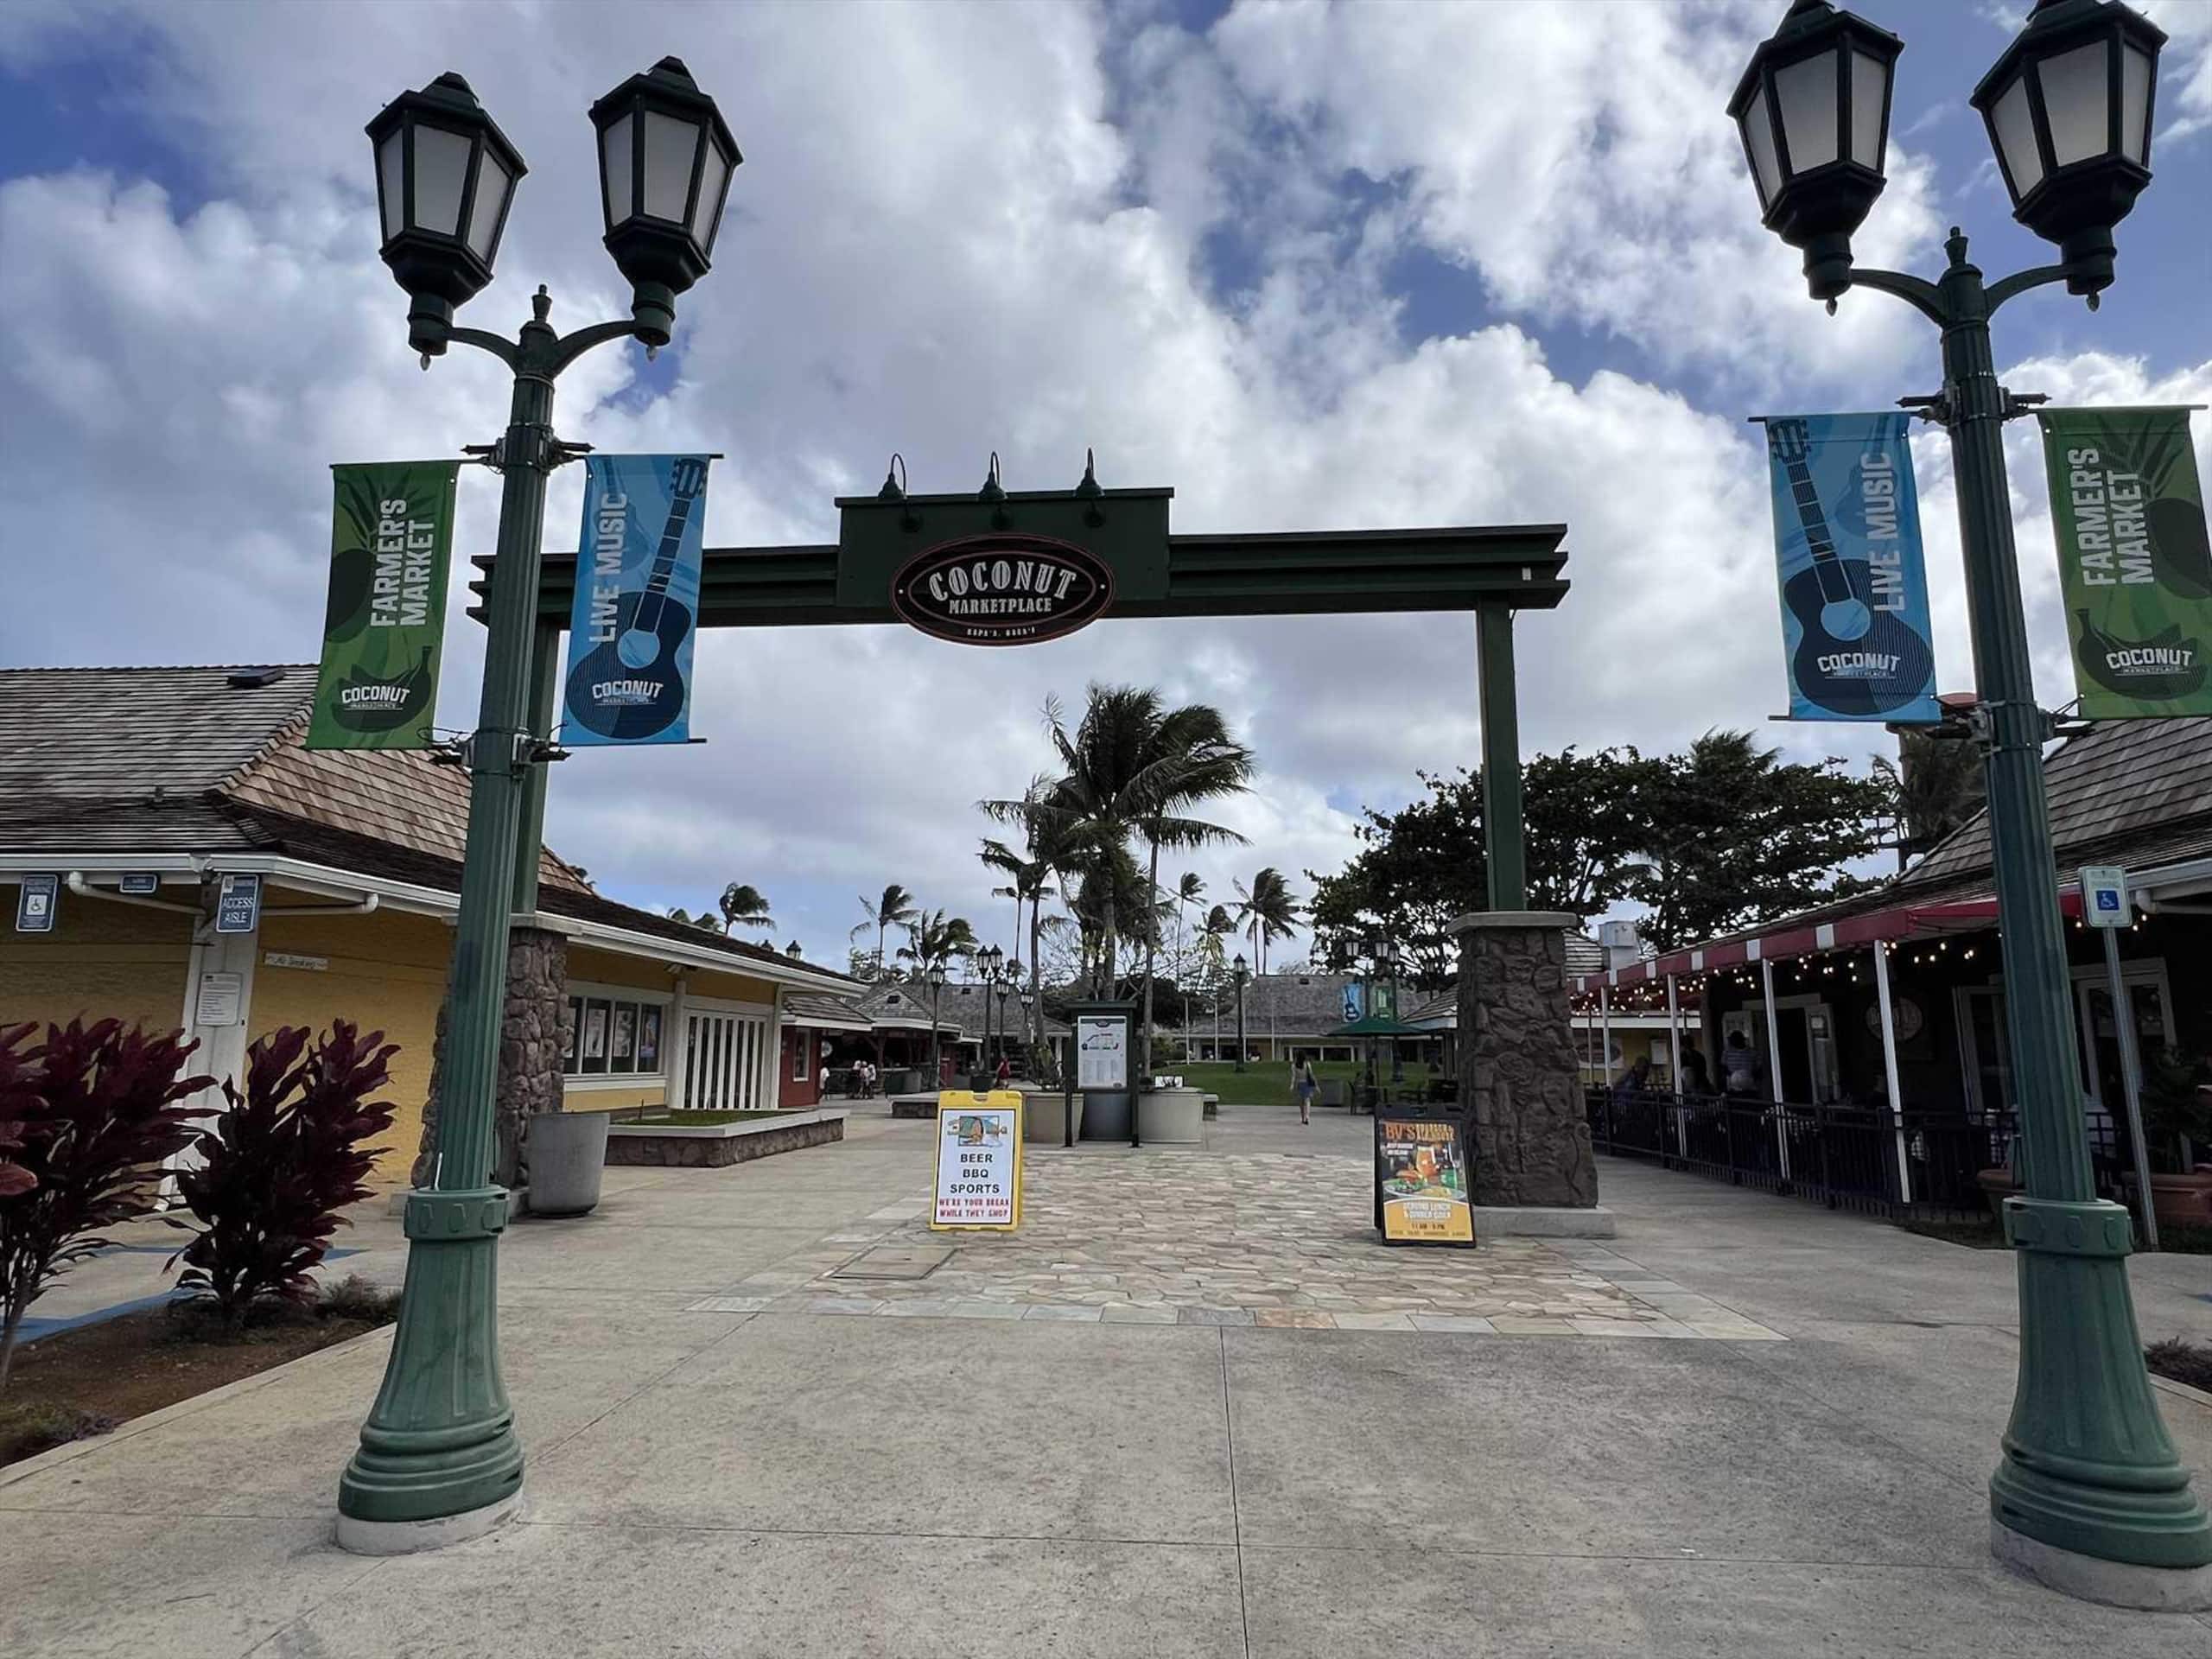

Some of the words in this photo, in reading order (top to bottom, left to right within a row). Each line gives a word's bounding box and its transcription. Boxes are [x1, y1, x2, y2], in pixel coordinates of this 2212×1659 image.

[1861, 452, 1897, 540] MUSIC
[596, 493, 627, 575] MUSIC
[2068, 448, 2116, 587] FARMER'S
[2107, 470, 2154, 584] MARKET
[370, 499, 408, 627] FARMER'S
[400, 521, 435, 626] MARKET
[929, 560, 1077, 601] COCONUT
[1869, 551, 1905, 612] LIVE
[588, 585, 620, 644] LIVE
[949, 597, 1052, 614] MARKETPLACE
[1817, 652, 1901, 672] COCONUT
[2106, 648, 2192, 669] COCONUT
[341, 685, 410, 703] COCONUT
[592, 680, 664, 699] COCONUT
[960, 1154, 993, 1163] BEER
[963, 1169, 989, 1179] BBQ
[950, 1184, 1000, 1194] SPORTS
